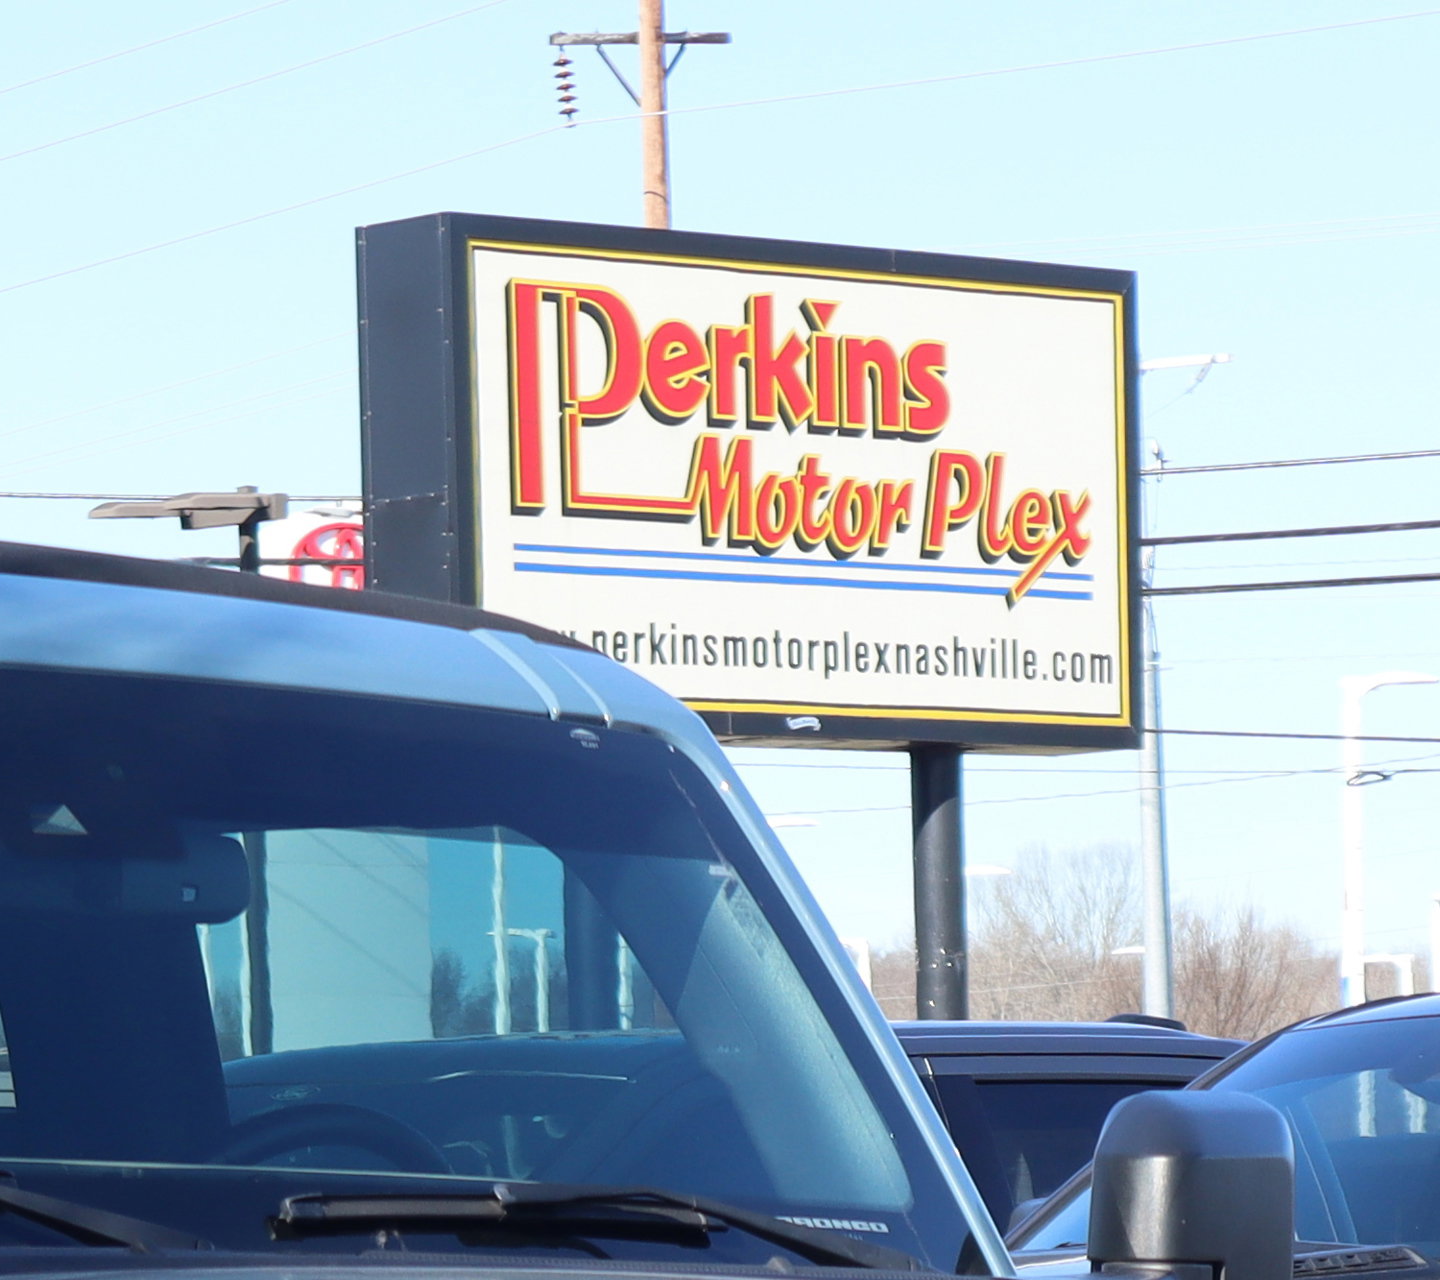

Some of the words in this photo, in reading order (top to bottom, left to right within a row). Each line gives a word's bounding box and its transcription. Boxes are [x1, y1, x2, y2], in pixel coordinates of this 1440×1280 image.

[506, 278, 952, 516] Perkins
[690, 432, 916, 561] Motor
[919, 448, 1094, 611] Plex
